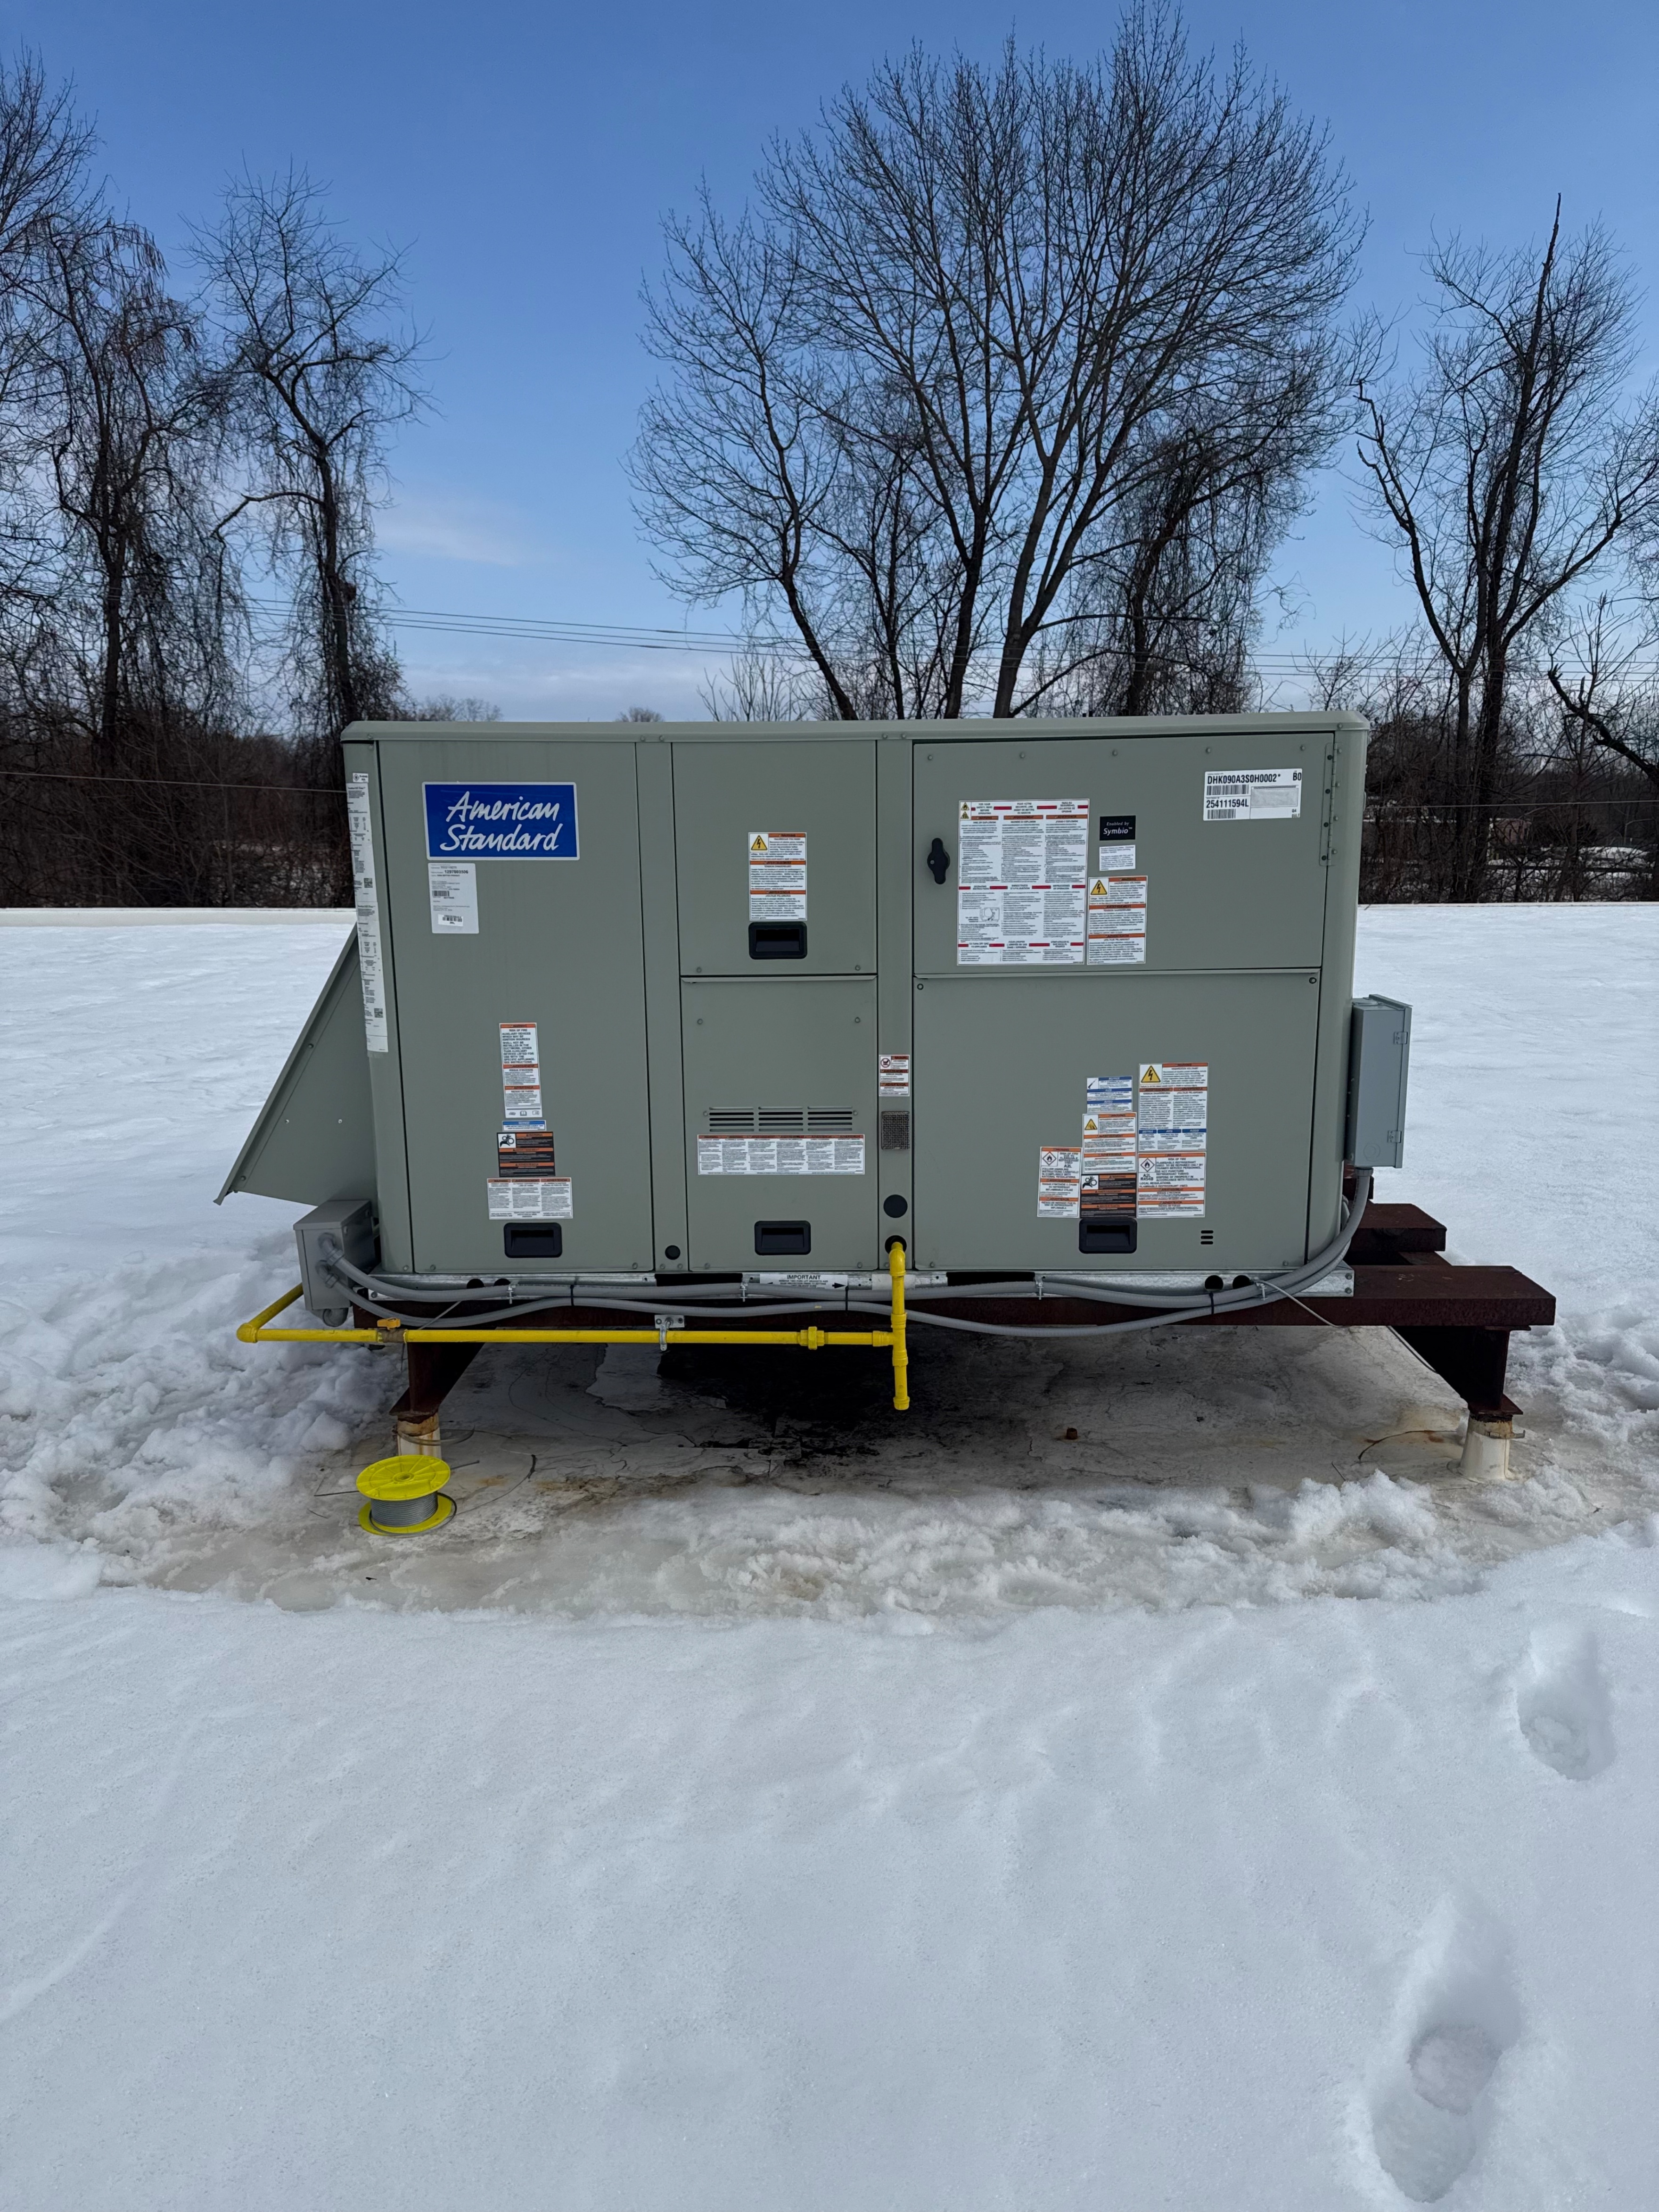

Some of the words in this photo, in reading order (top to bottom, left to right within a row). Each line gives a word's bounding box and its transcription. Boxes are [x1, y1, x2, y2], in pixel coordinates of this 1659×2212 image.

[446, 791, 559, 822] American
[1206, 799, 1249, 809] 254111594L
[440, 823, 563, 851] Standard
